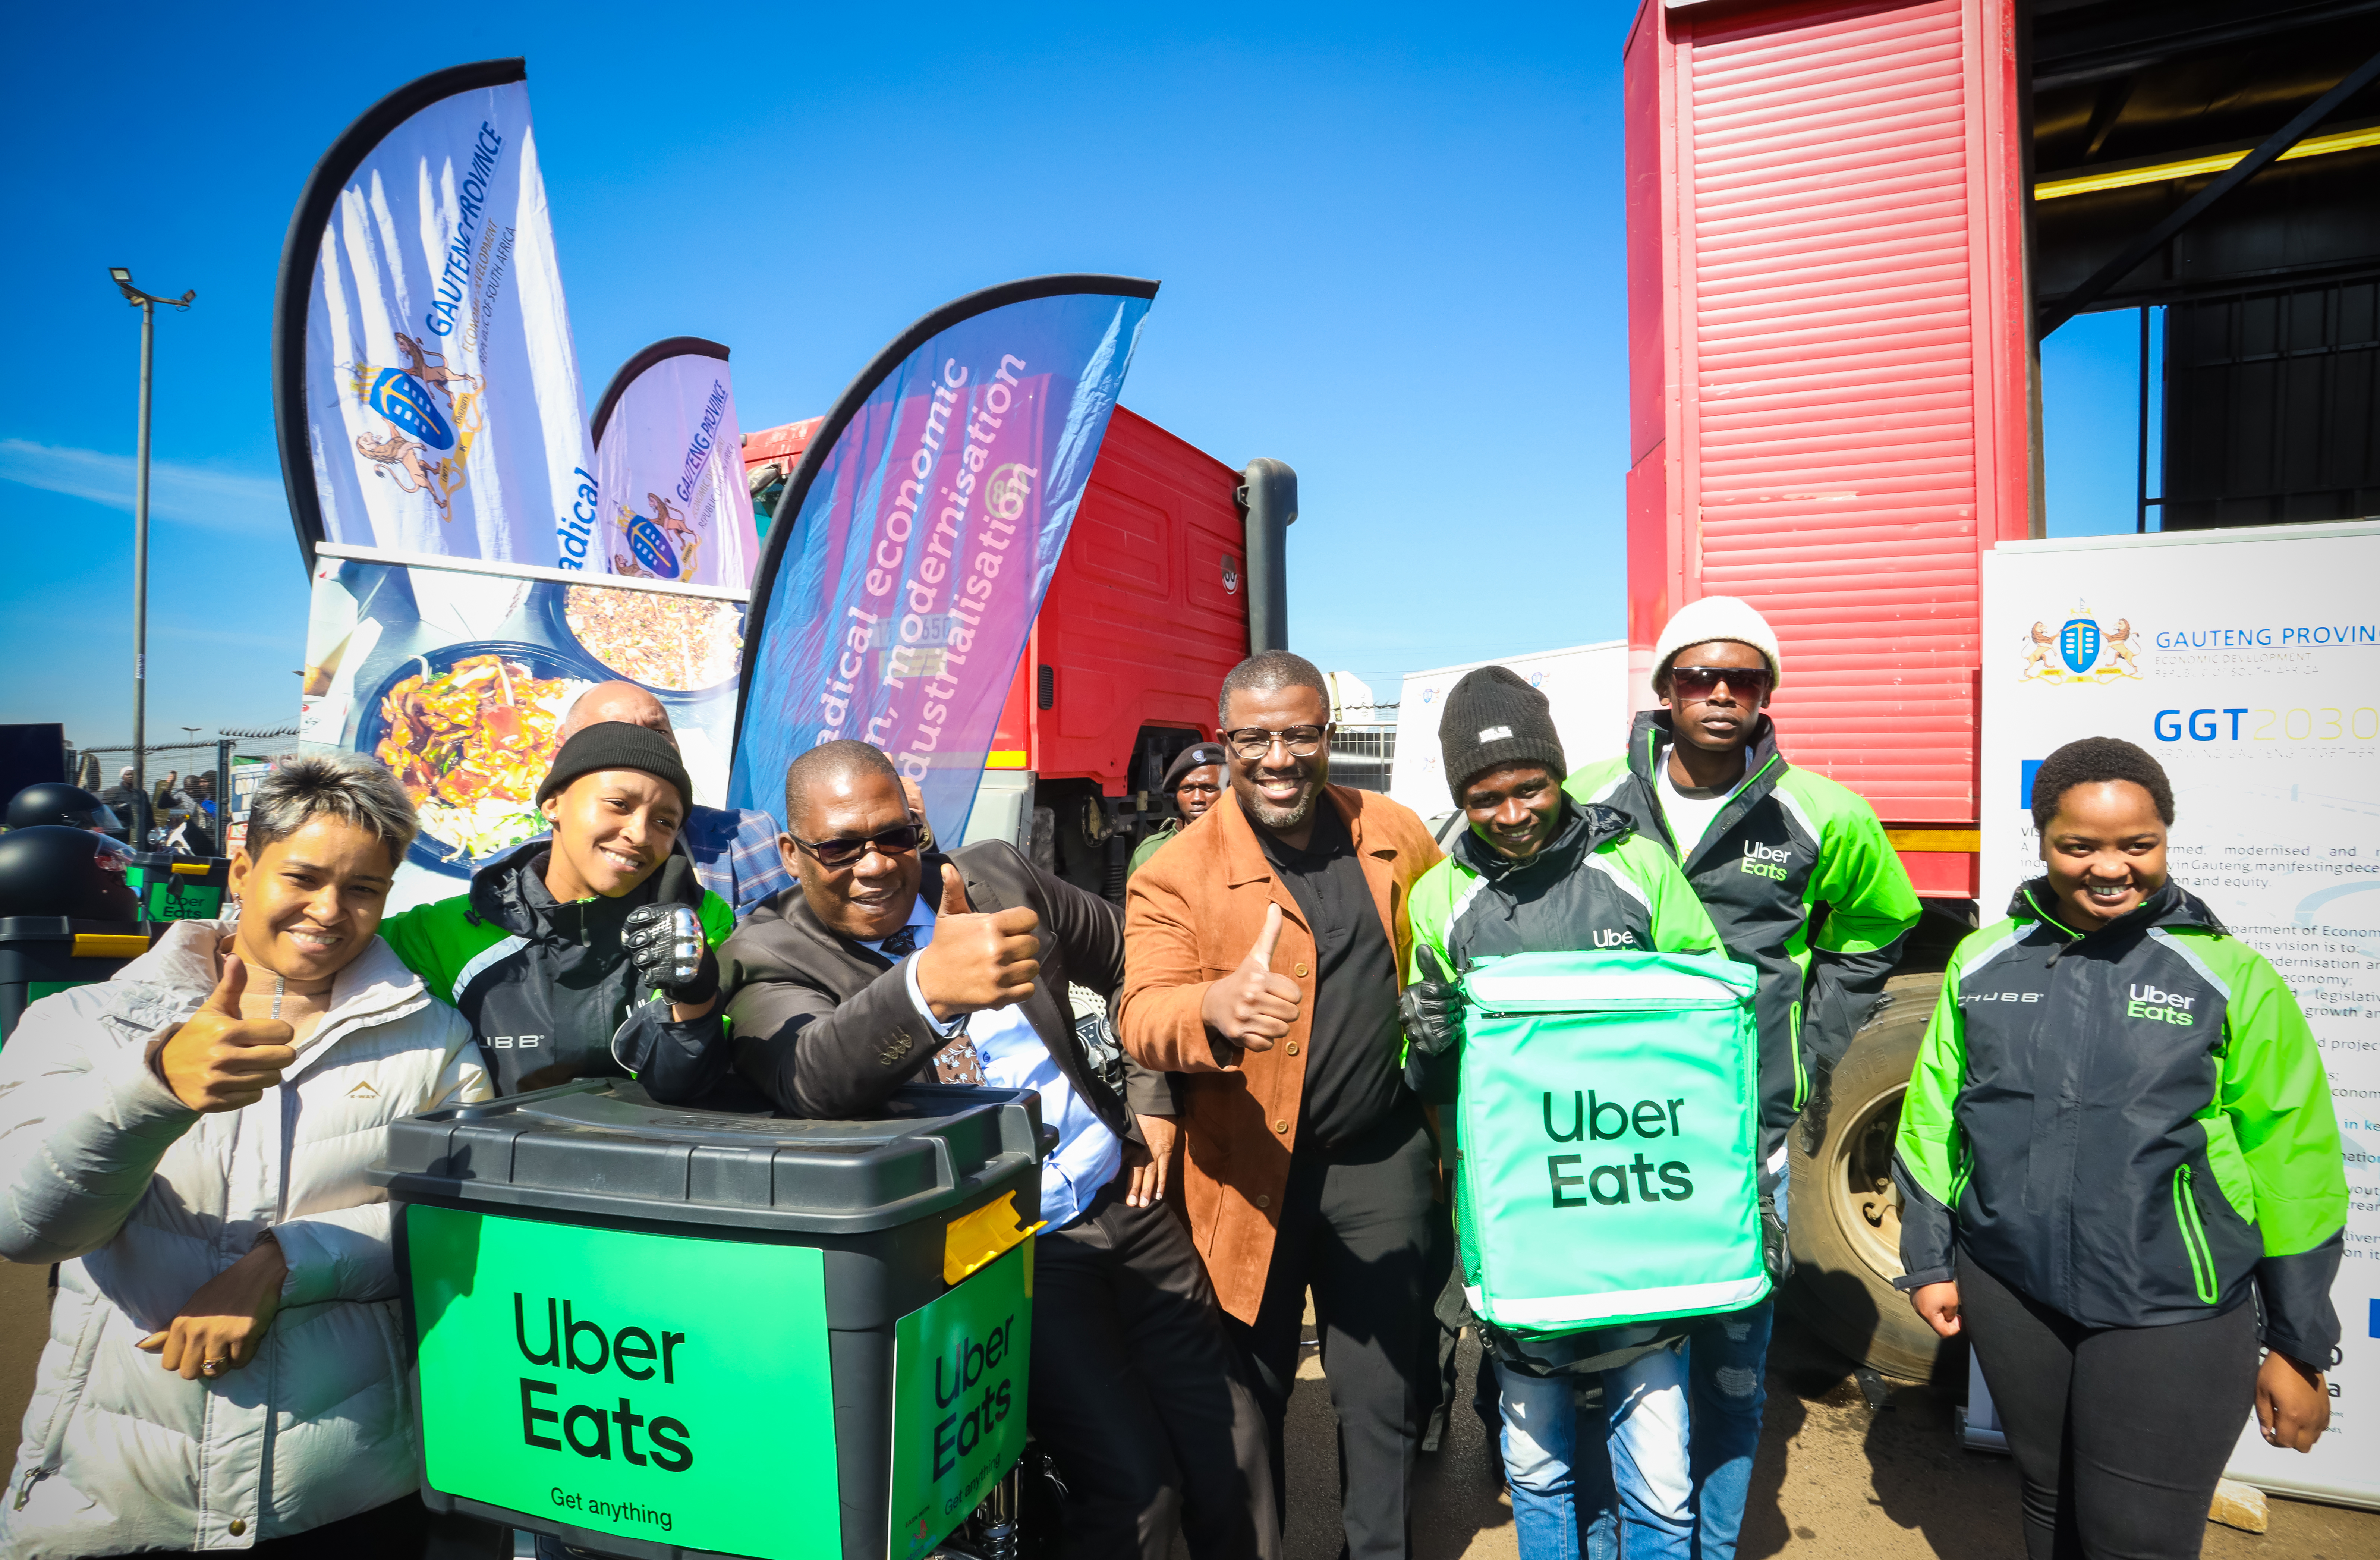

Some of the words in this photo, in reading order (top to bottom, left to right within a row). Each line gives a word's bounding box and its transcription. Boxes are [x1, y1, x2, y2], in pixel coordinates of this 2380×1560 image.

[486, 263, 504, 303] SOUTH
[495, 227, 516, 266] AFRICA
[677, 433, 709, 502] GAUTENG
[558, 467, 598, 569] adical
[883, 353, 1026, 689] modernisation
[815, 606, 877, 746] adical
[865, 358, 967, 597] economic
[899, 464, 1038, 782] dustrialisation
[2156, 629, 2271, 648] GAUTENG
[2283, 625, 2380, 644] PROVIN
[2156, 655, 2218, 665] ECONOMIC
[2223, 652, 2312, 663] DEVELOPMENT
[2154, 707, 2379, 742] GGT2030
[1744, 840, 1791, 863] Uber
[2225, 846, 2310, 856] modernised
[2329, 846, 2356, 857] and
[1741, 857, 1788, 881] Eats
[2177, 860, 2189, 869] in
[2255, 861, 2343, 875] manifesting
[2345, 862, 2380, 873] dece
[2194, 876, 2219, 886] and
[2225, 877, 2272, 889] equity.
[1593, 928, 1636, 948] Ube
[2225, 925, 2299, 935] epartment
[2302, 925, 2317, 935] of
[2323, 926, 2380, 937] Econom
[2255, 940, 2270, 950] its
[2275, 941, 2320, 952] vision
[2325, 942, 2336, 952] is
[2266, 957, 2360, 969] odernisation
[2129, 983, 2195, 1009] Uber
[2315, 989, 2380, 1003] legislativ
[2127, 1000, 2193, 1026] Eats
[2305, 1006, 2357, 1018] growth
[2331, 1039, 2380, 1052] projec
[1543, 1090, 1685, 1143] Uber
[2344, 1119, 2358, 1130] in
[1547, 1153, 1694, 1208] Eats
[515, 1292, 685, 1384] Uber
[935, 1313, 1014, 1409] Uber
[520, 1377, 693, 1472] Eats
[933, 1378, 1011, 1484] Eats
[945, 1493, 963, 1516] Get
[965, 1453, 1001, 1498] anything
[551, 1486, 584, 1511] Get
[589, 1496, 672, 1531] anything
